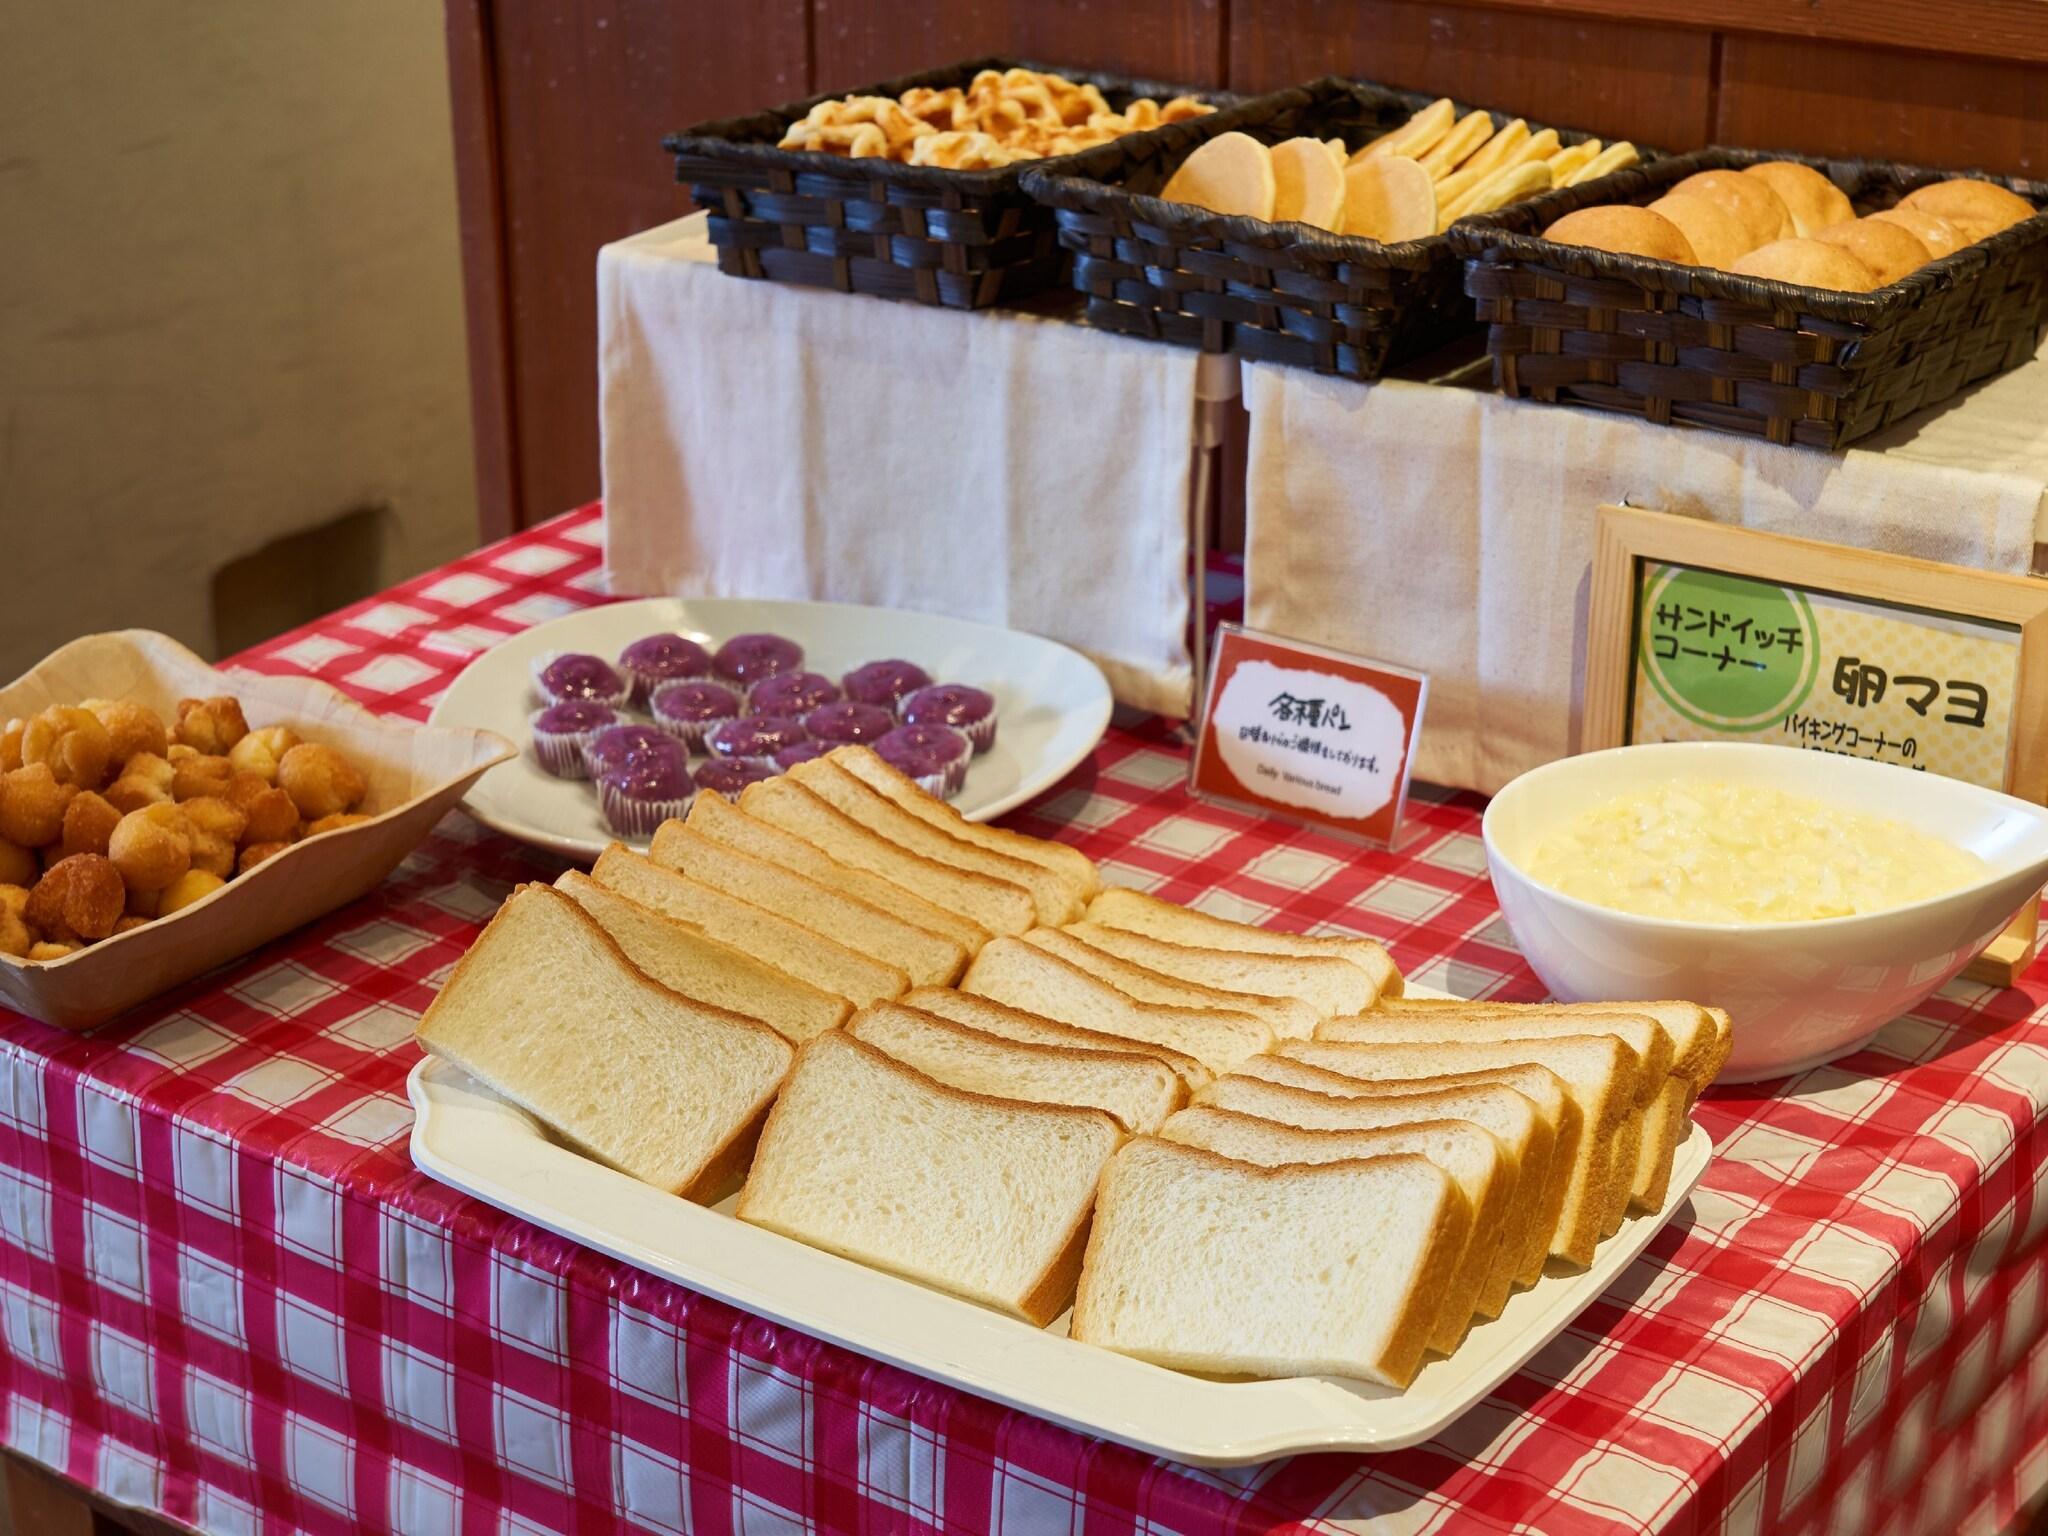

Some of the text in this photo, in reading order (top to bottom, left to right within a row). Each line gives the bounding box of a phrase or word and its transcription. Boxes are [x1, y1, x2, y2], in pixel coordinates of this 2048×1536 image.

[1656, 603, 1803, 654] サンドイッチ
[1654, 634, 1767, 671] コーナー
[1268, 691, 1352, 731] 各種パン
[1832, 655, 1989, 728] 卵マヨ
[1784, 713, 1917, 759] バイキングコーナーの
[1256, 762, 1279, 780] Daily
